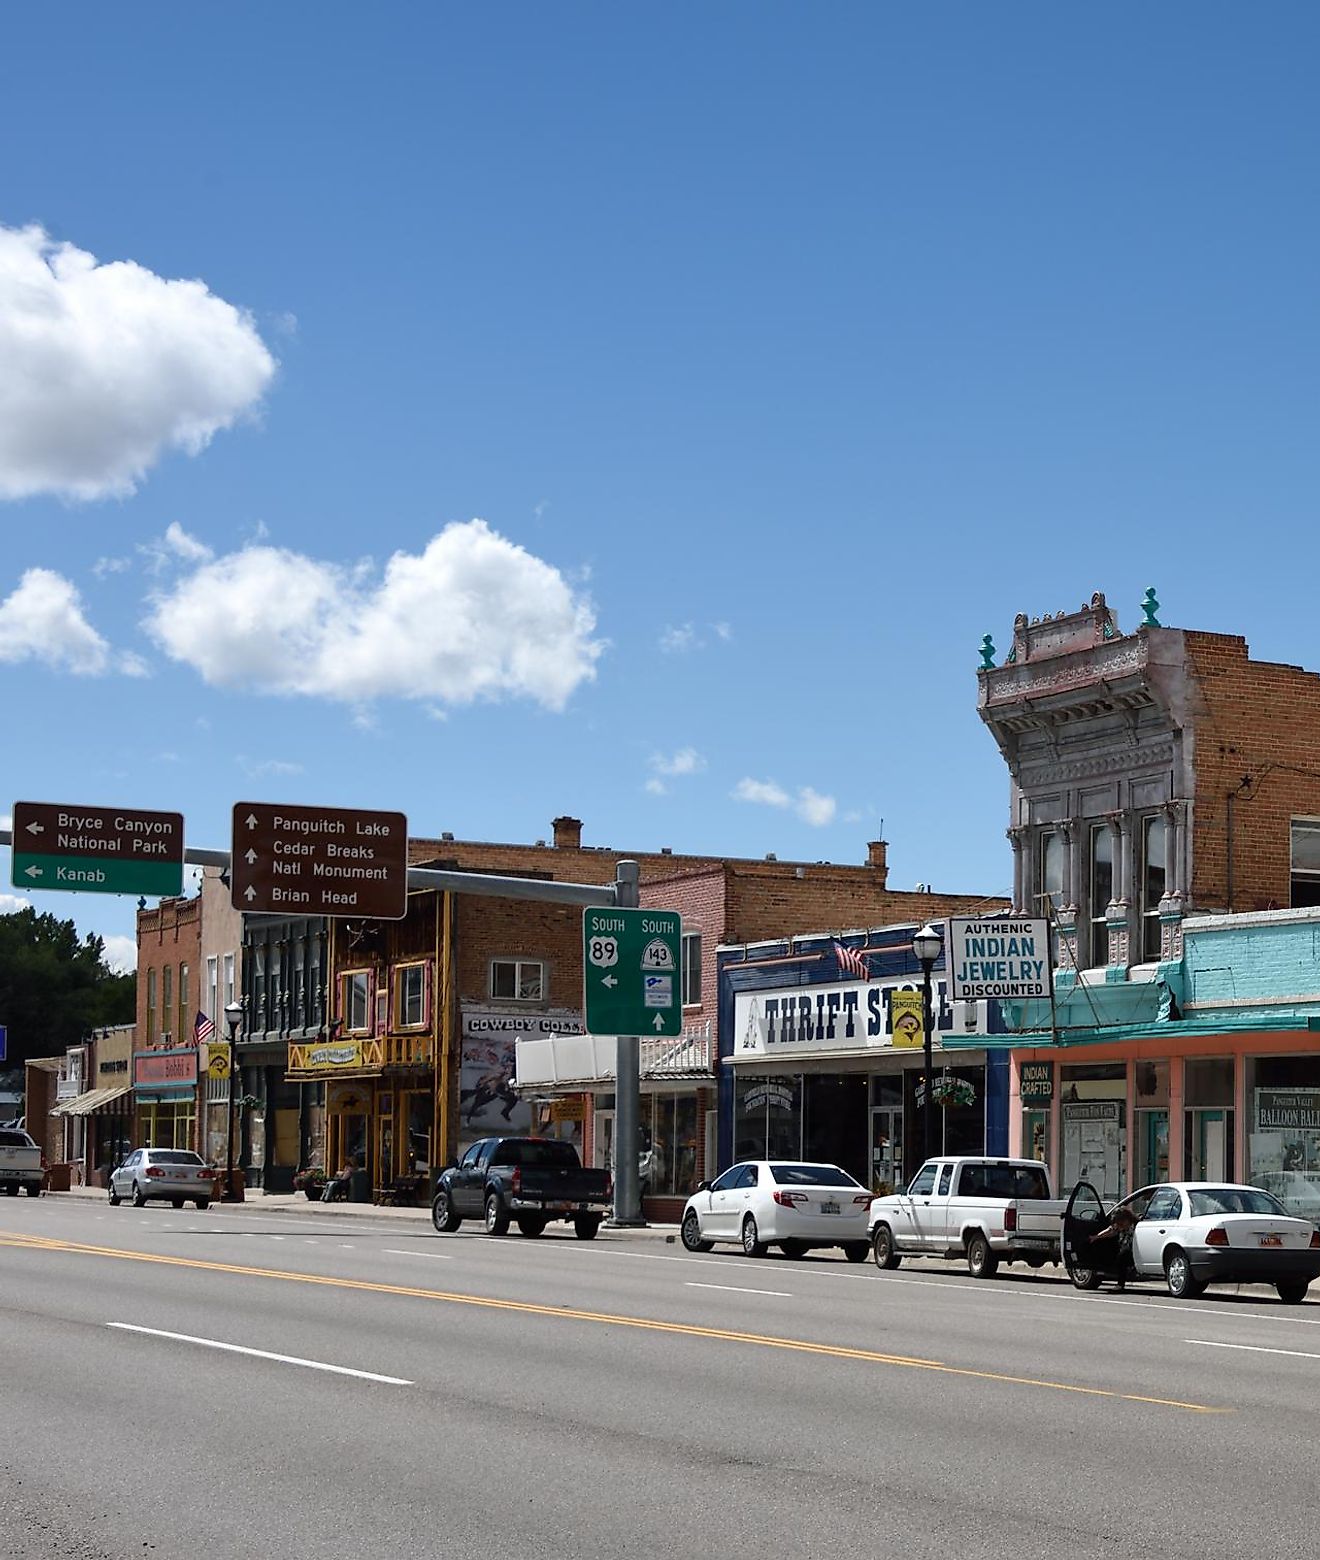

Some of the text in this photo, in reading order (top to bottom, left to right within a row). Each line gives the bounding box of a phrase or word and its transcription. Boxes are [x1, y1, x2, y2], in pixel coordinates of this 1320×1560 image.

[58, 813, 173, 836] Bryce Canyon
[273, 816, 391, 837] Panguitch Lake
[57, 834, 168, 854] National Park
[273, 840, 375, 860] Cedar Breaks
[56, 866, 106, 883] Kanab
[272, 860, 388, 880] Natl Monument
[272, 887, 358, 905] Brian Head
[592, 916, 625, 932] SOUTH
[641, 918, 675, 934] SOUTH
[964, 923, 1033, 934] AUTHENIC
[592, 941, 615, 960] 89
[649, 948, 668, 961] 143
[965, 937, 1035, 958] INDIAN
[957, 960, 1044, 982] JEWELRY
[962, 983, 1043, 996] DISCOUNTED
[469, 1018, 537, 1032] COWBOY
[766, 991, 859, 1043] THRIFT
[1024, 1066, 1049, 1080] INDIAN
[1021, 1081, 1052, 1096] CRAFTED
[1260, 1108, 1299, 1126] BALLOON
